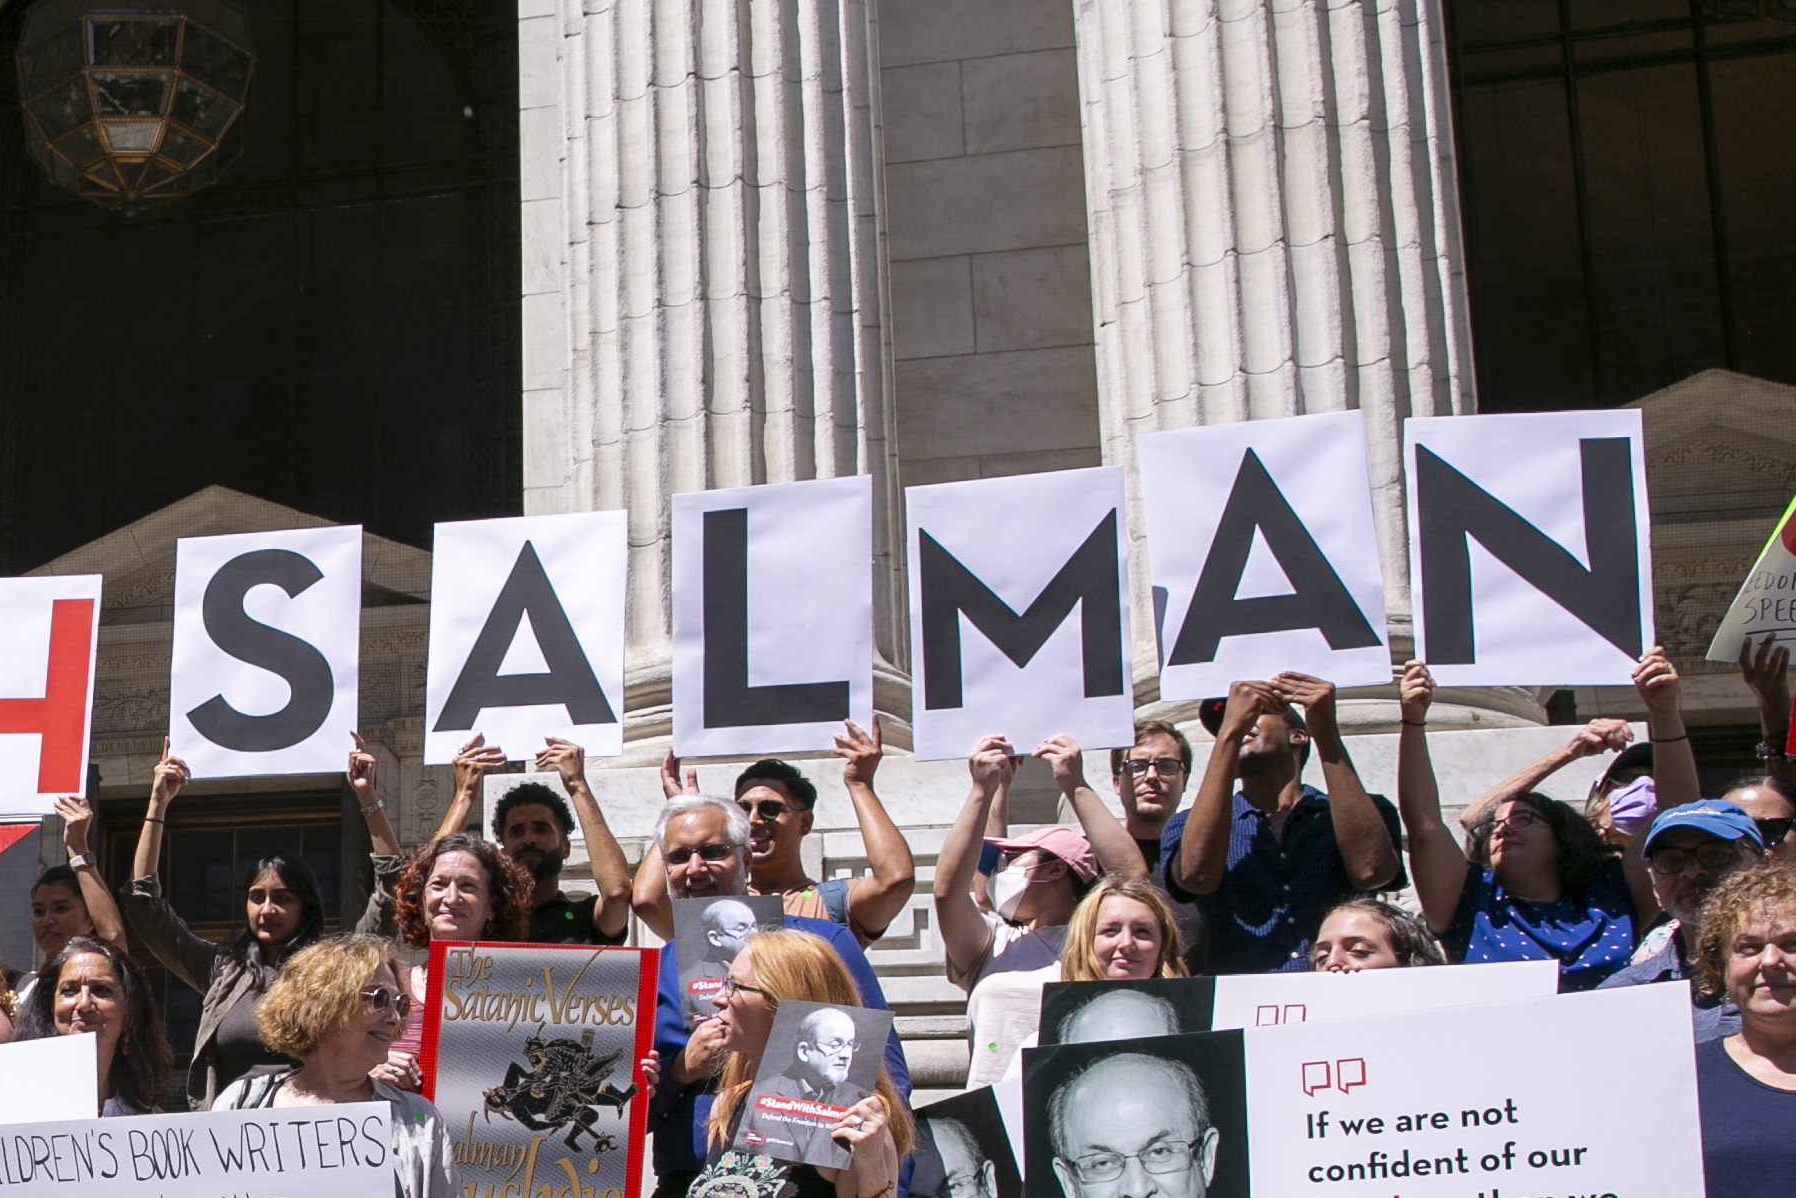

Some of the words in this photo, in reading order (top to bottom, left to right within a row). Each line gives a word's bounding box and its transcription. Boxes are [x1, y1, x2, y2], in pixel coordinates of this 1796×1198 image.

[444, 976, 546, 1032] Satanic
[541, 945, 634, 1026] Verses
[450, 949, 493, 988] The
[760, 1097, 843, 1118] #StandWithSalm
[1306, 1111, 1330, 1139] If
[1339, 1116, 1385, 1136] we
[1395, 1111, 1450, 1132] are
[1461, 1098, 1518, 1128] not
[131, 1127, 201, 1182] BOOK
[209, 1115, 388, 1174] WRITERS
[453, 1110, 527, 1182] alman
[1308, 1148, 1469, 1183] confident
[1480, 1142, 1517, 1171] of
[1528, 1144, 1588, 1169] our
